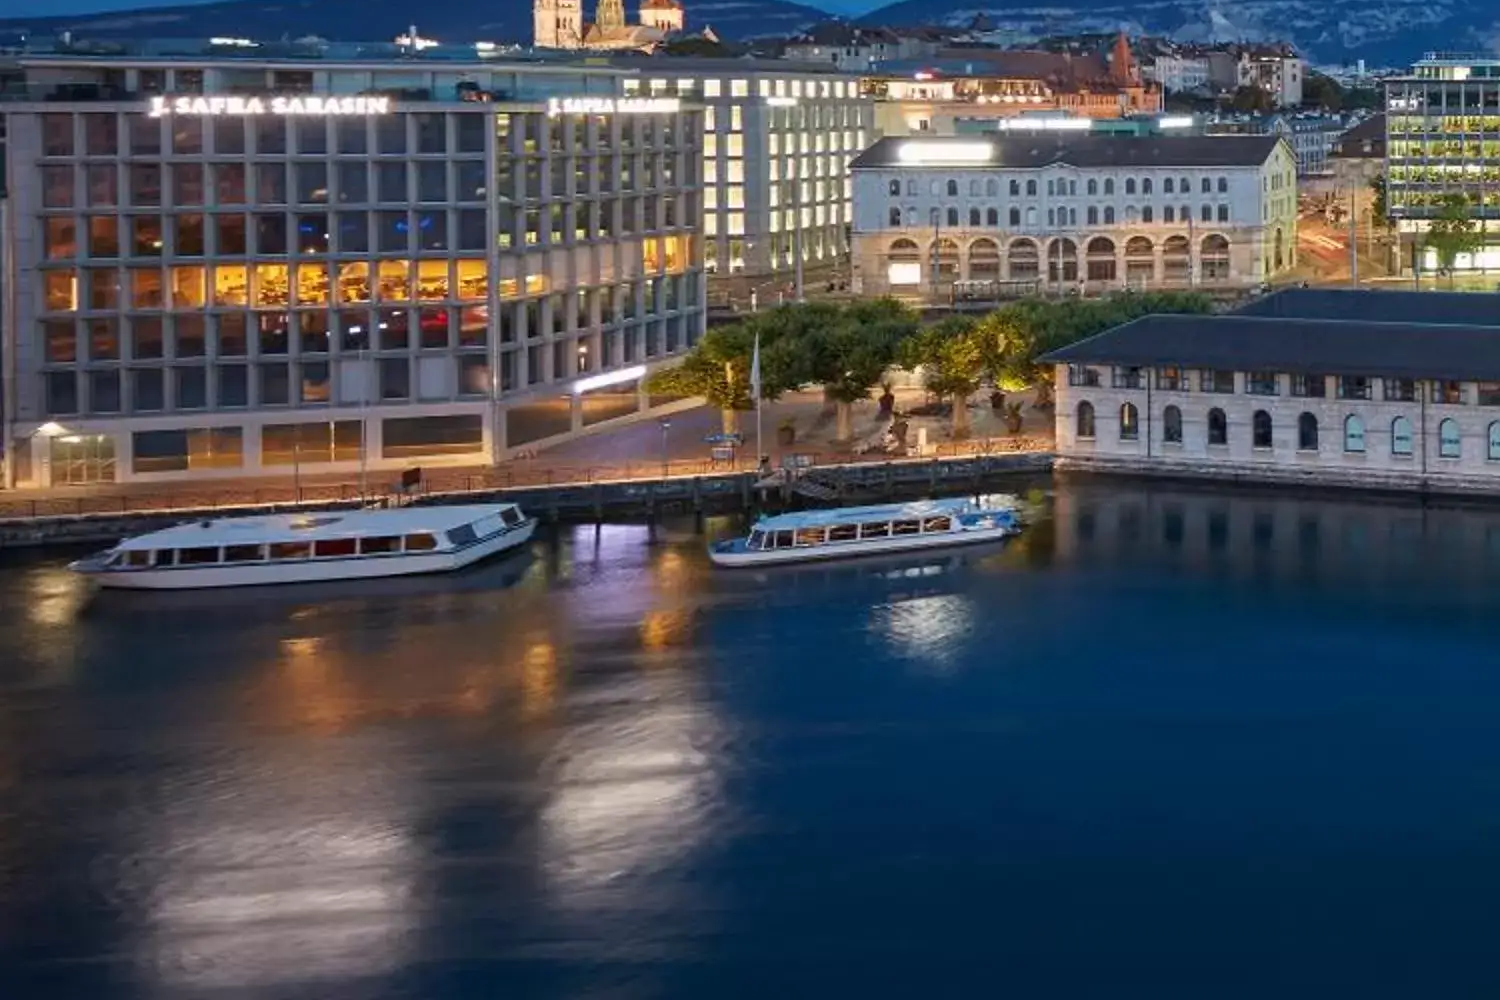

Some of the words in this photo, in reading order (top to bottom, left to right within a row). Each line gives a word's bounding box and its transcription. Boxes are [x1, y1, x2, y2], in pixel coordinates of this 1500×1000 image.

[151, 97, 169, 117] J.
[175, 96, 264, 114] SAFRA
[271, 96, 389, 114] SARASIN
